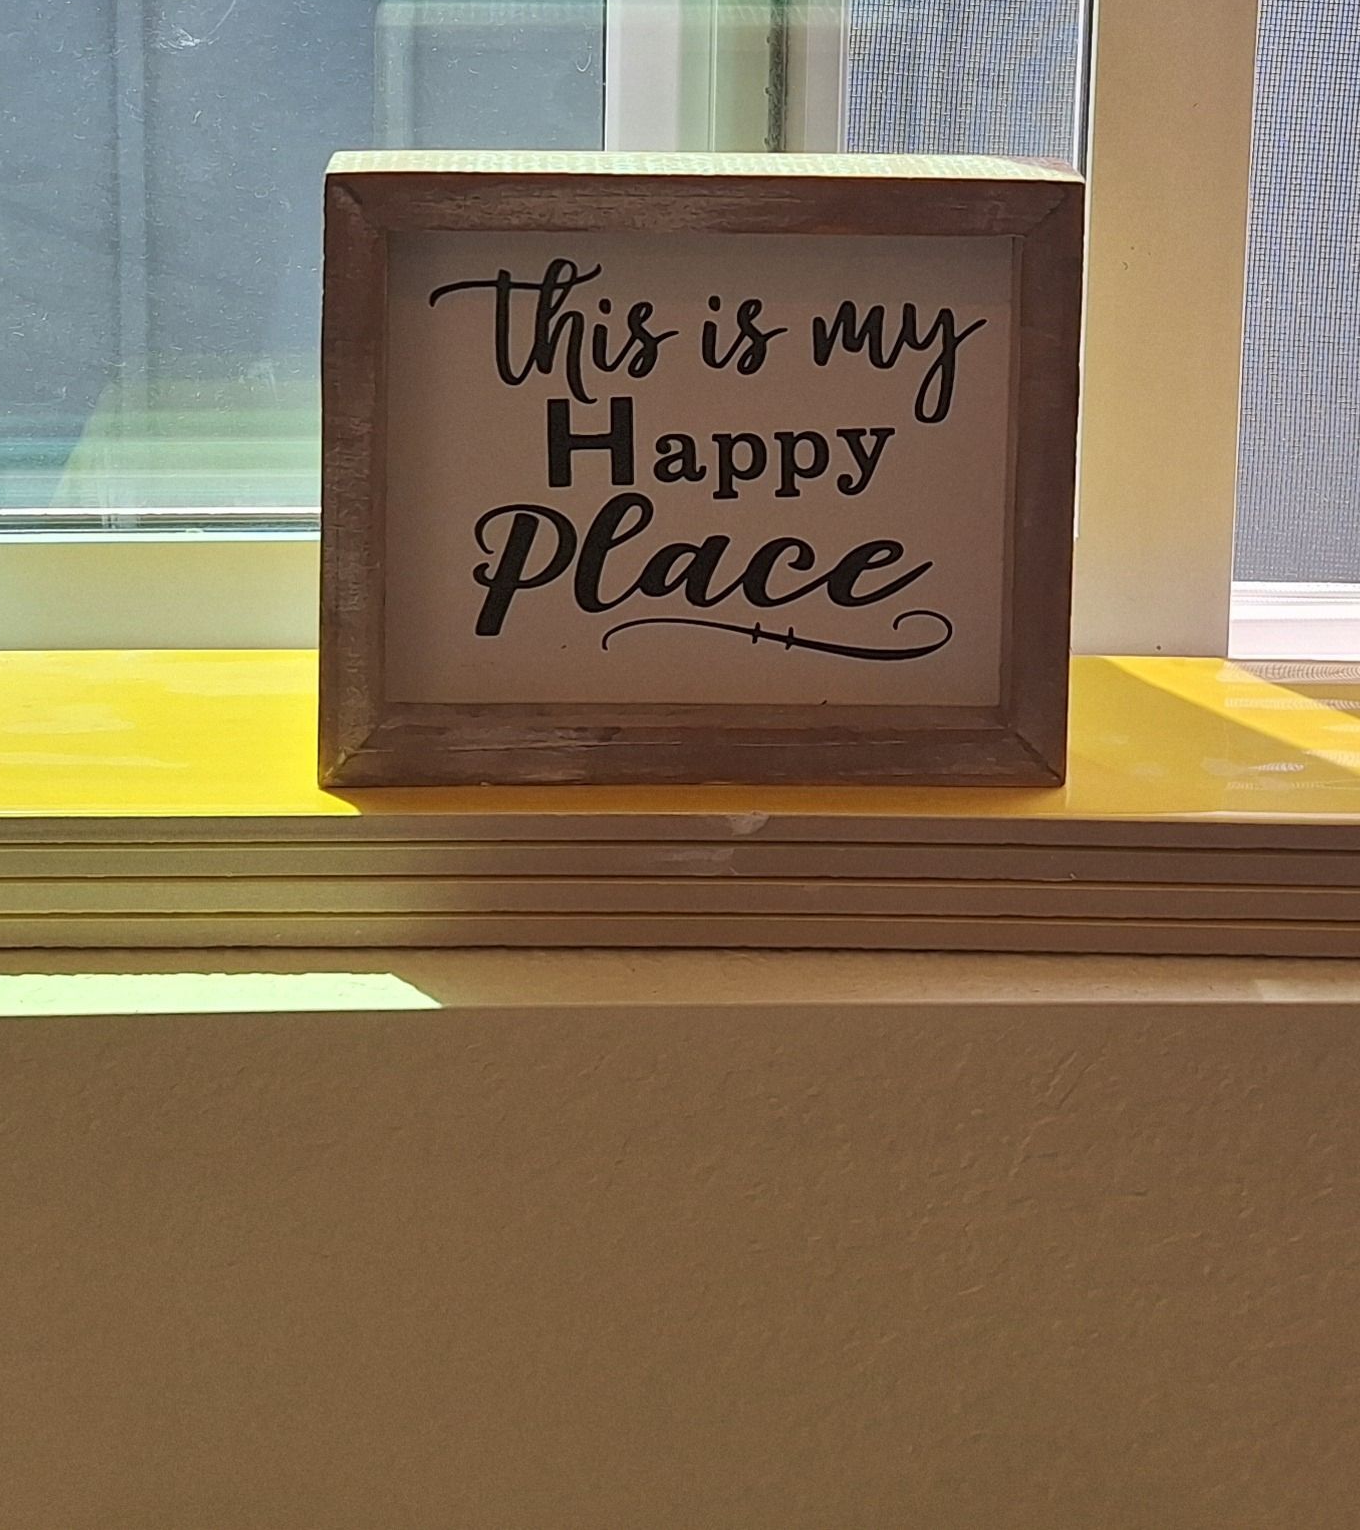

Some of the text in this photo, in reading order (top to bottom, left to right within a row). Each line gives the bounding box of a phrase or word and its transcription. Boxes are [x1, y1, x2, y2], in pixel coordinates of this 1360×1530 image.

[701, 295, 789, 376] is
[812, 300, 988, 424] my
[546, 396, 896, 500] Happy
